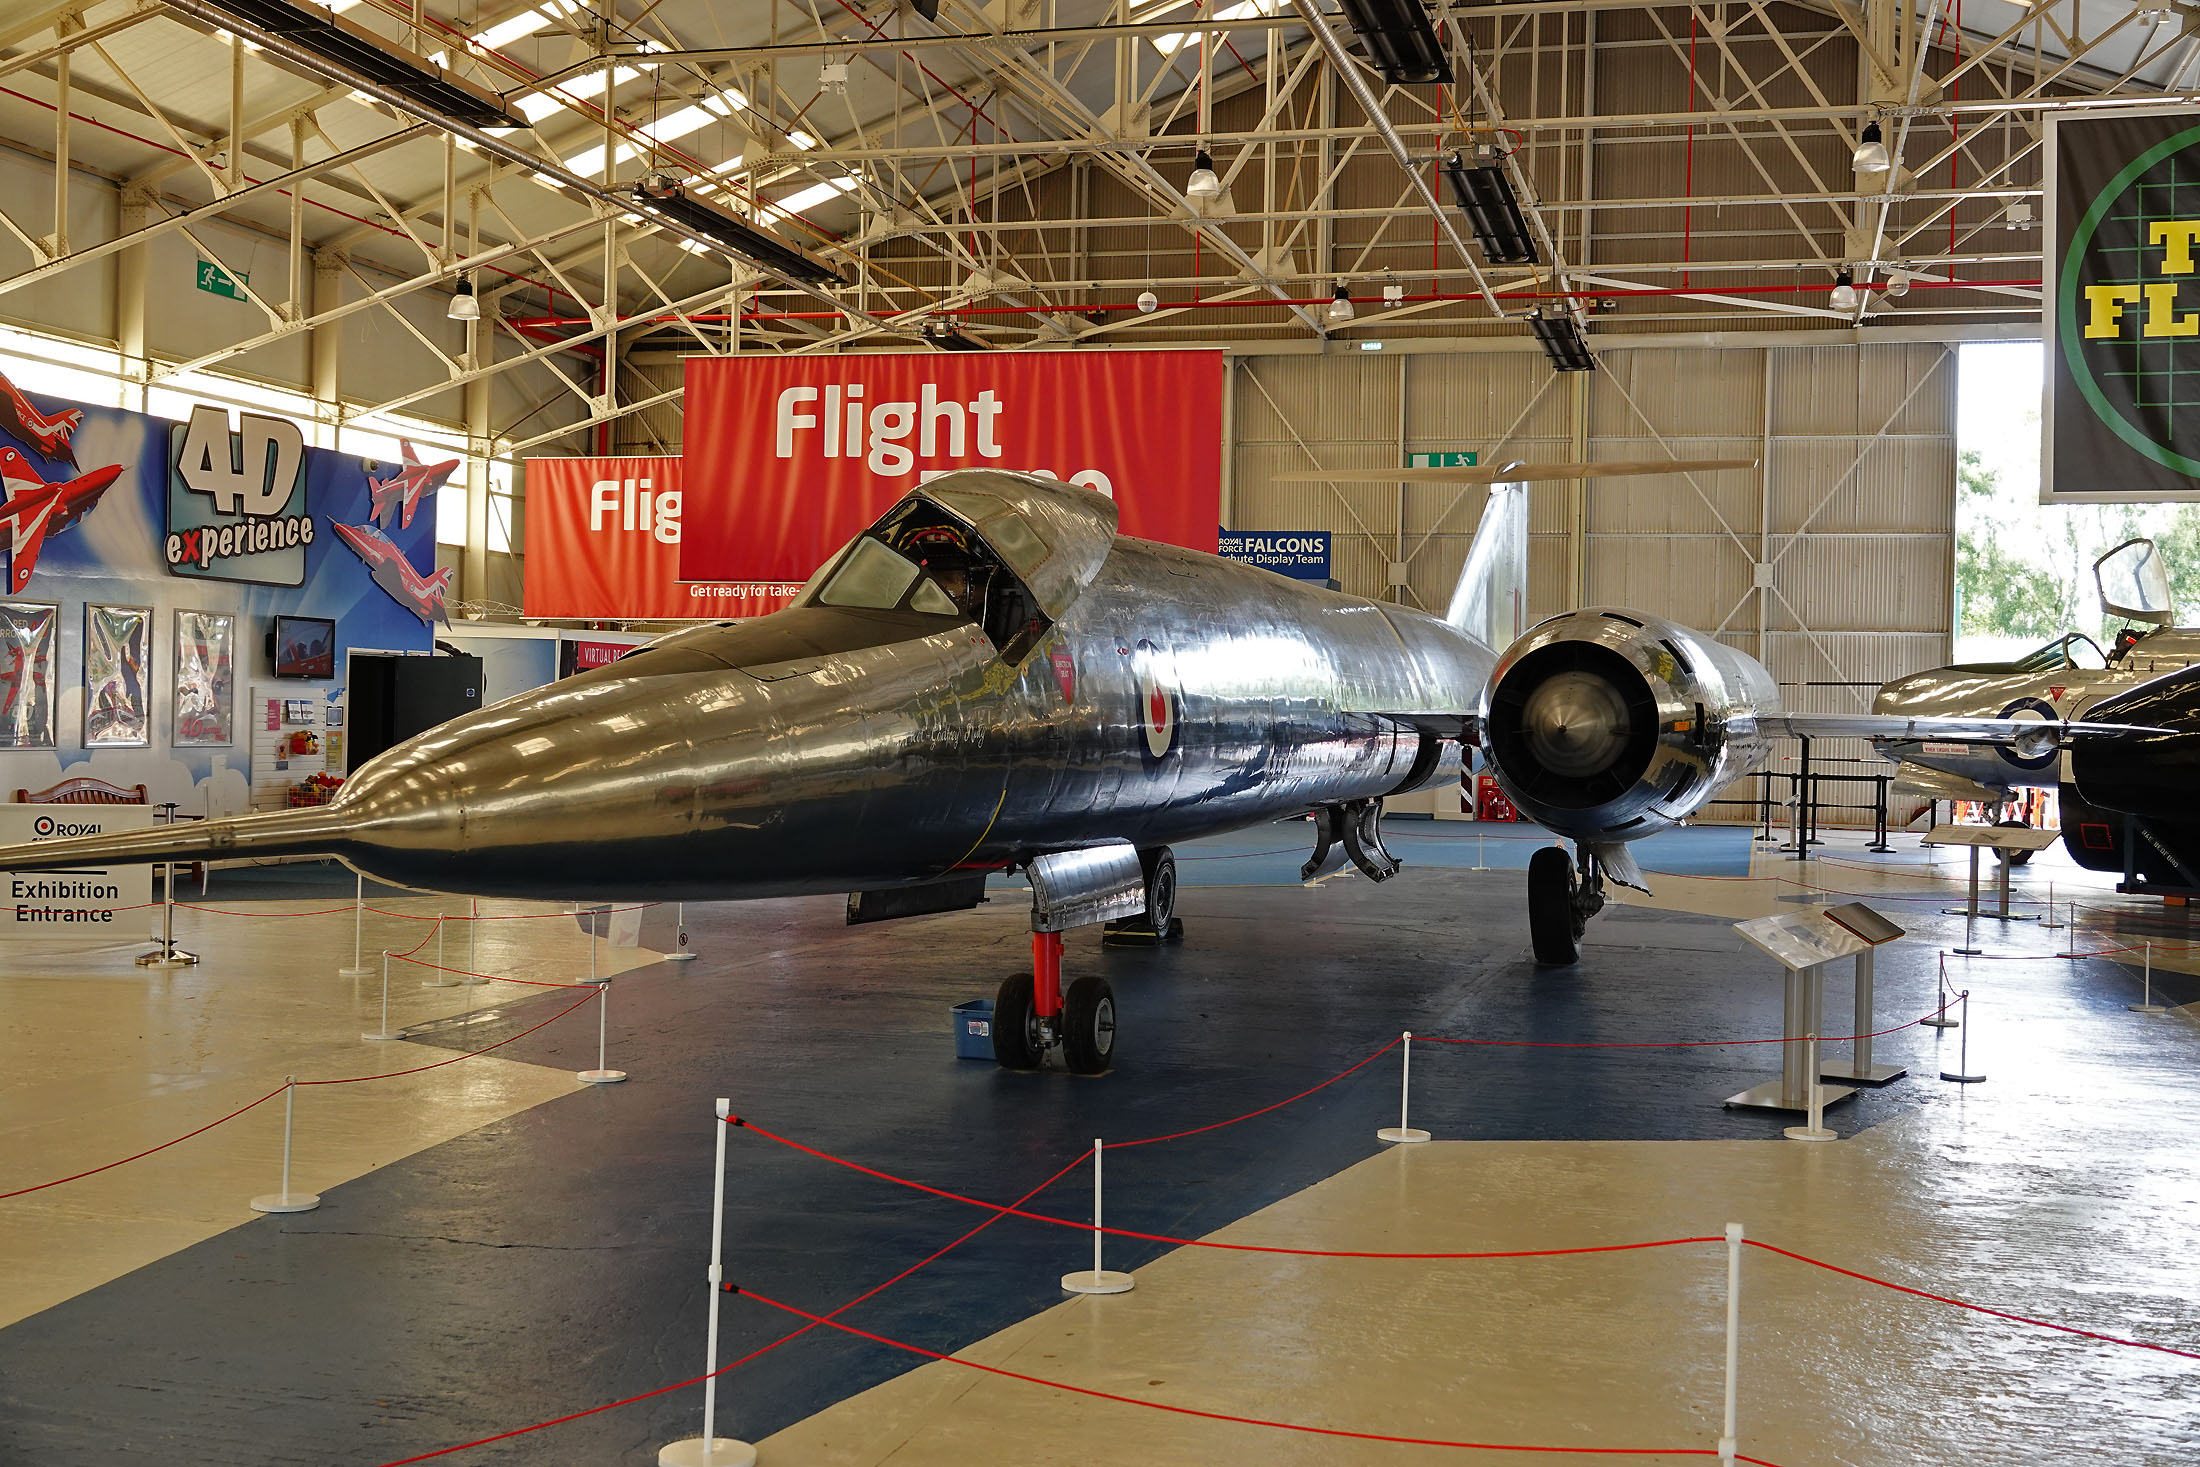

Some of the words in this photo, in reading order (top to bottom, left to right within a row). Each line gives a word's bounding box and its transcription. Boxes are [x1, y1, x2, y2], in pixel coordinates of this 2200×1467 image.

[2149, 220, 2200, 275] T
[2084, 283, 2199, 339] FL
[776, 383, 1003, 477] Flight
[178, 405, 304, 516] 4D
[590, 478, 682, 544] Flig
[167, 516, 314, 568] experience
[1218, 545, 1243, 553] FORCE
[1245, 538, 1324, 553] FALCONS
[1225, 553, 1254, 564] hute
[1256, 553, 1294, 566] Display
[1296, 554, 1324, 564] Team
[690, 585, 711, 597] Get
[713, 585, 747, 599] ready
[749, 585, 767, 597] for
[770, 585, 801, 597] take-
[584, 648, 611, 664] VIRTUAL
[11, 880, 118, 899] Exhibition
[16, 904, 113, 922] Entrance
